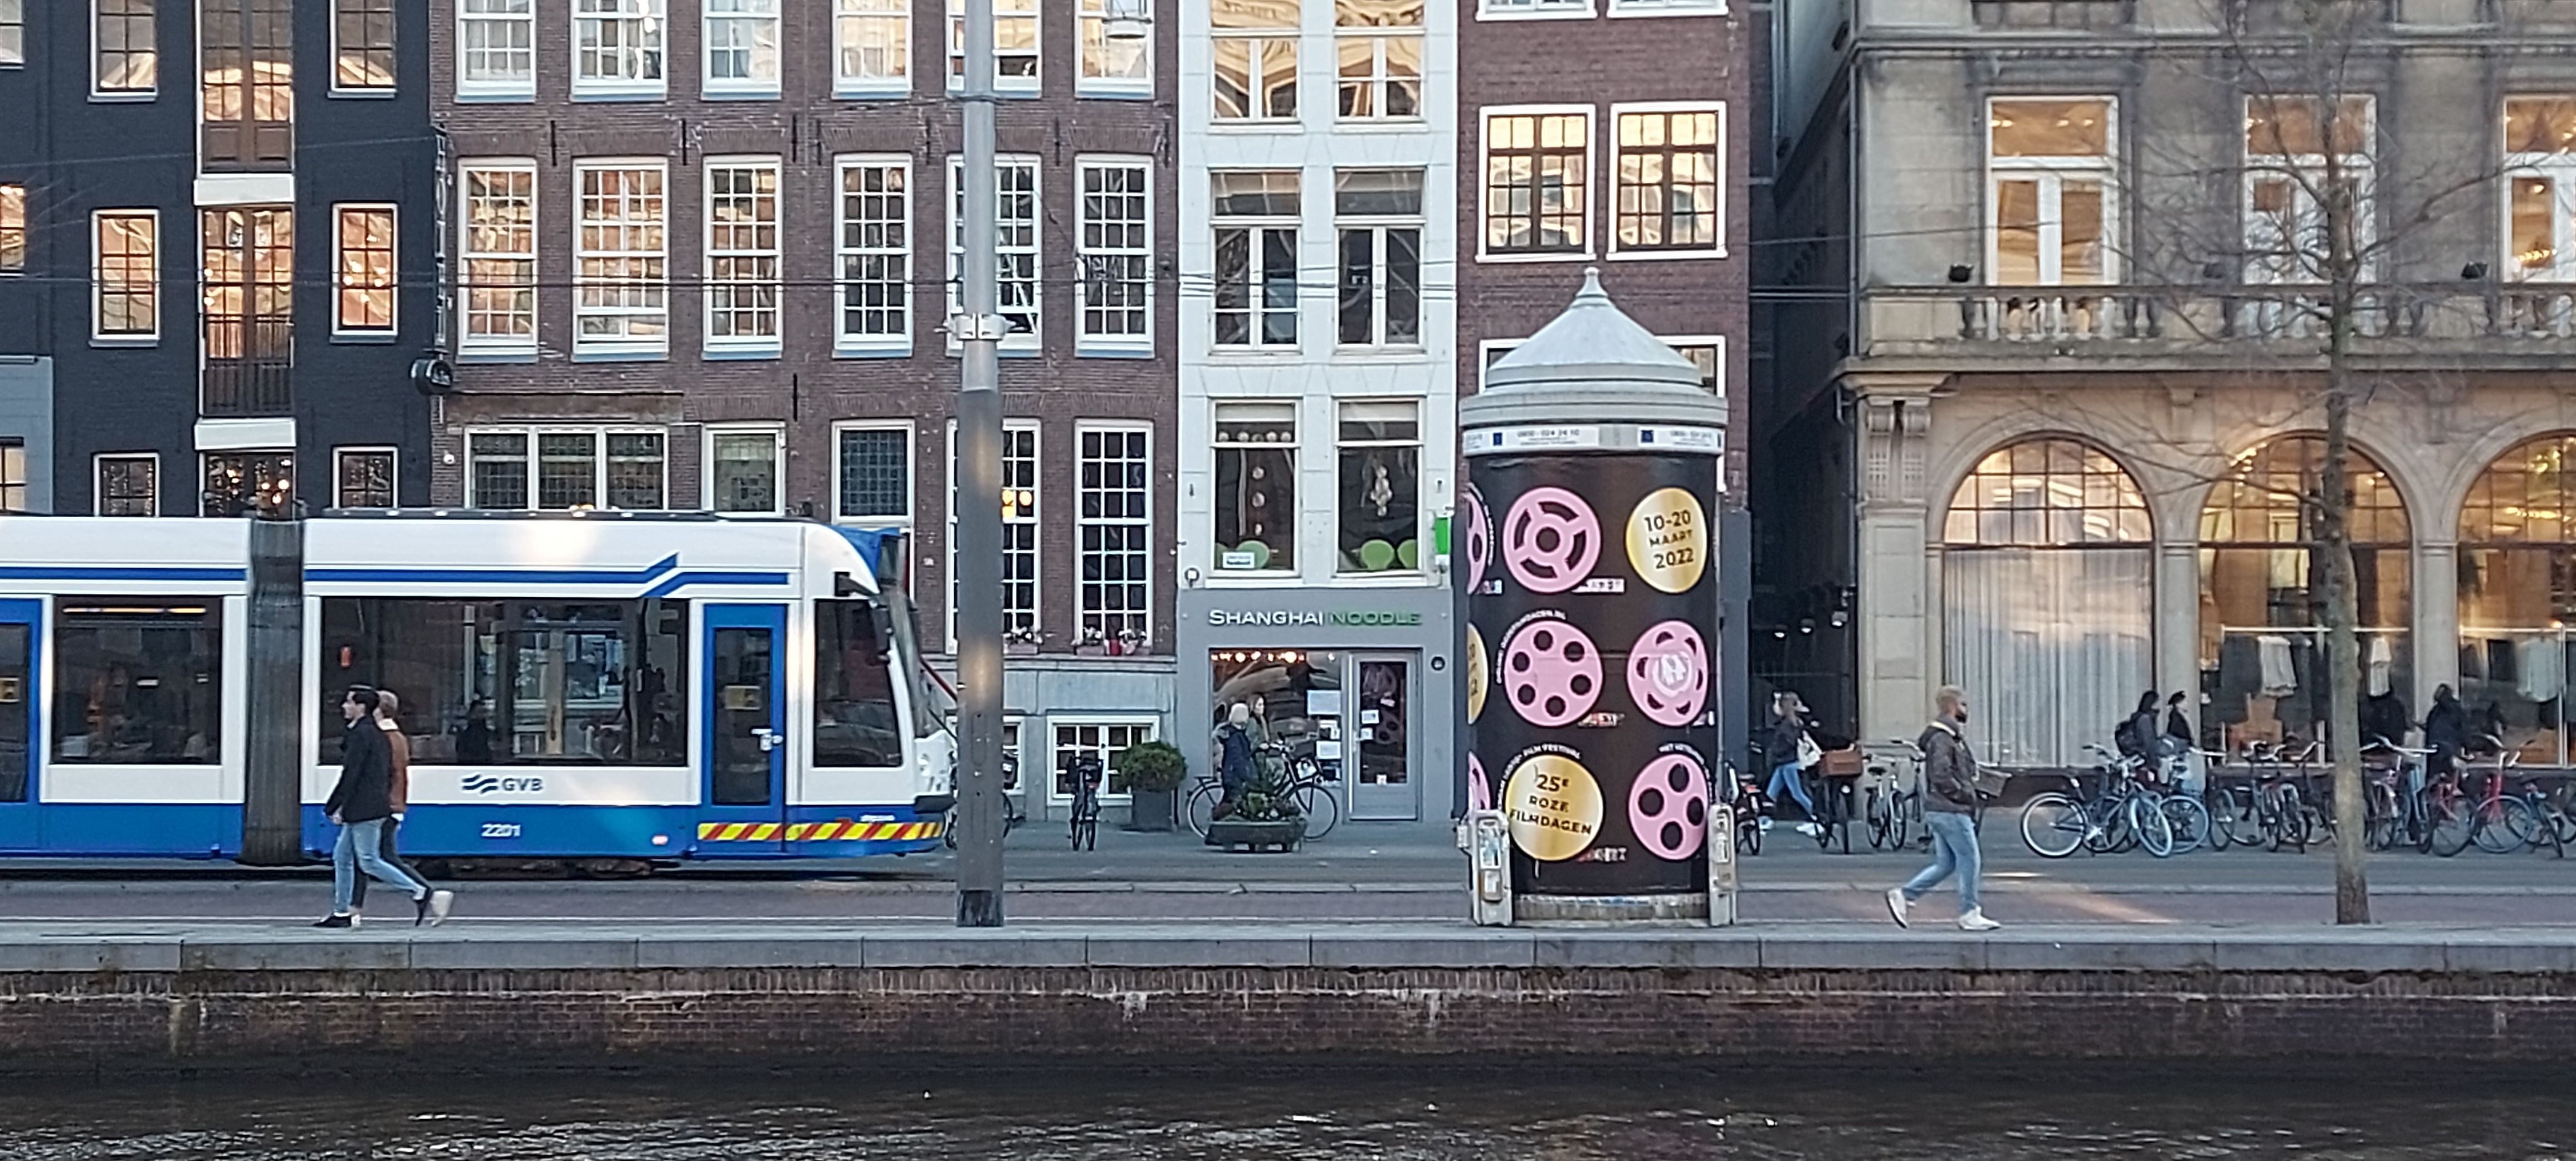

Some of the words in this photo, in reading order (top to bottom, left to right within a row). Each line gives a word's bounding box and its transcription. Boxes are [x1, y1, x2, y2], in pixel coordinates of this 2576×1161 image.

[1644, 509, 1691, 531] 10-20
[1649, 529, 1692, 547] MAART
[1653, 548, 1694, 569] 2022
[1209, 609, 1323, 626] SHANGHAI
[1330, 611, 1422, 626] NOODLE
[502, 778, 544, 792] GVB
[1529, 795, 1569, 813] ROZE
[481, 823, 521, 837] 2201
[1509, 808, 1592, 835] FILMDAGEN
